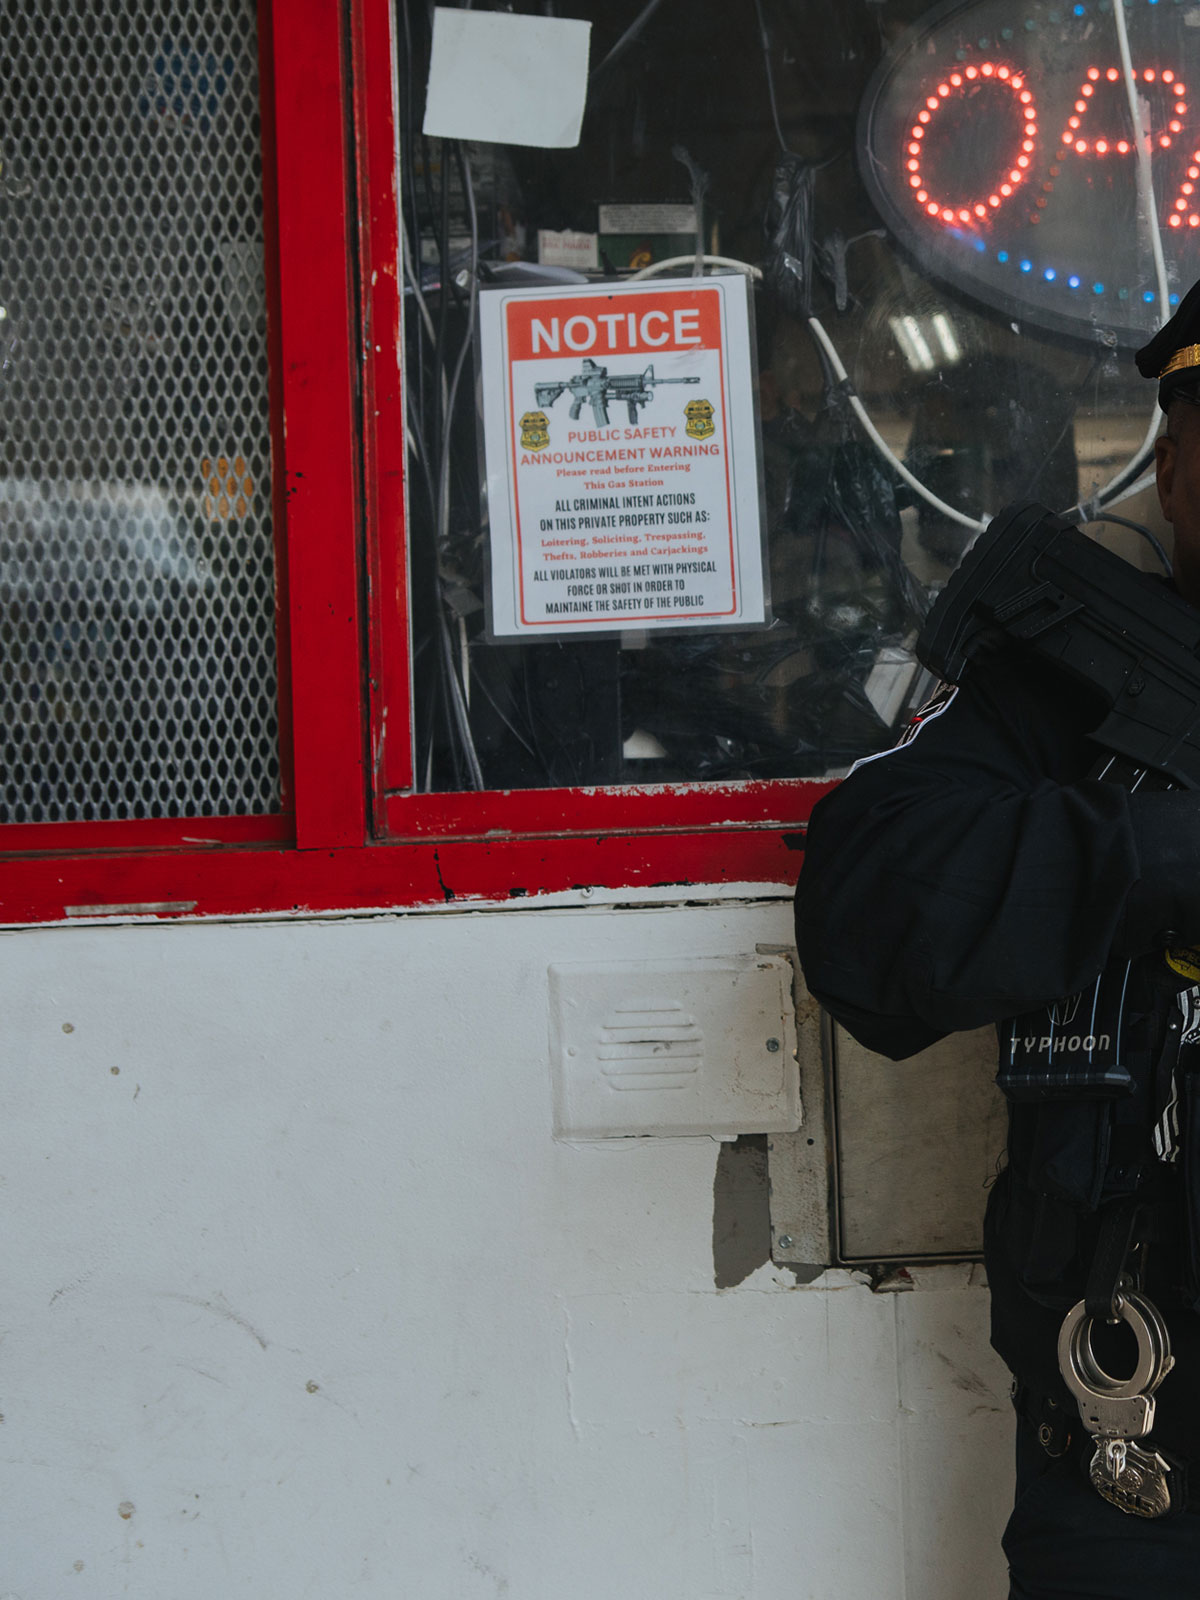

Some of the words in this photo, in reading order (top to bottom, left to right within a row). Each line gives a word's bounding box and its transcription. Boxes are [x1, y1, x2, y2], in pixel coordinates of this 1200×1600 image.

[530, 308, 702, 353] NOTICE
[568, 429, 621, 443] PUBLIC
[624, 426, 677, 440] SAFETY
[520, 448, 646, 466] ANNOUNCEMENT
[650, 444, 720, 459] WARNING
[556, 468, 587, 478] Please
[590, 466, 612, 476] read
[614, 464, 645, 475] before
[647, 462, 691, 475] Entering
[584, 480, 606, 490] This
[608, 479, 626, 490] Gas
[628, 477, 664, 488] Station
[555, 499, 571, 512] ALL
[573, 497, 619, 511] CRIMINAL
[622, 495, 654, 508] INTENT
[656, 493, 696, 507] ACTIONS
[540, 518, 553, 532] ON
[555, 518, 576, 531] THIS
[578, 515, 616, 529] PRIVATE
[619, 513, 665, 527] PROPERTY
[668, 511, 693, 525] SUCH
[695, 511, 711, 523] AS:
[541, 537, 589, 549] Loitering,
[592, 533, 642, 546] Soliciting,
[644, 530, 707, 543] Trespassing,
[542, 552, 577, 562] Thefts,
[580, 549, 628, 560] Robberies
[630, 547, 648, 557] and
[650, 544, 708, 557] Carjackings
[533, 570, 548, 582] ALL
[550, 568, 597, 581] VIOLATORS
[598, 566, 619, 579] WILL
[621, 565, 632, 577] BE
[633, 564, 650, 576] MET
[652, 563, 674, 575] WITH
[676, 561, 717, 574] PHYSICAL
[567, 584, 594, 597] FORCE
[596, 583, 608, 595] OR
[609, 581, 631, 595] SHOT
[633, 581, 643, 593] IN
[644, 580, 673, 593] ORDER
[675, 579, 685, 591] TO
[545, 601, 593, 614] MAINTAINE
[595, 600, 611, 612] THE
[612, 598, 642, 611] SAFETY
[644, 597, 654, 609] OF
[655, 597, 671, 608] THE
[673, 595, 704, 607] PUBLIC
[1010, 1034, 1111, 1054] TYPHOON
